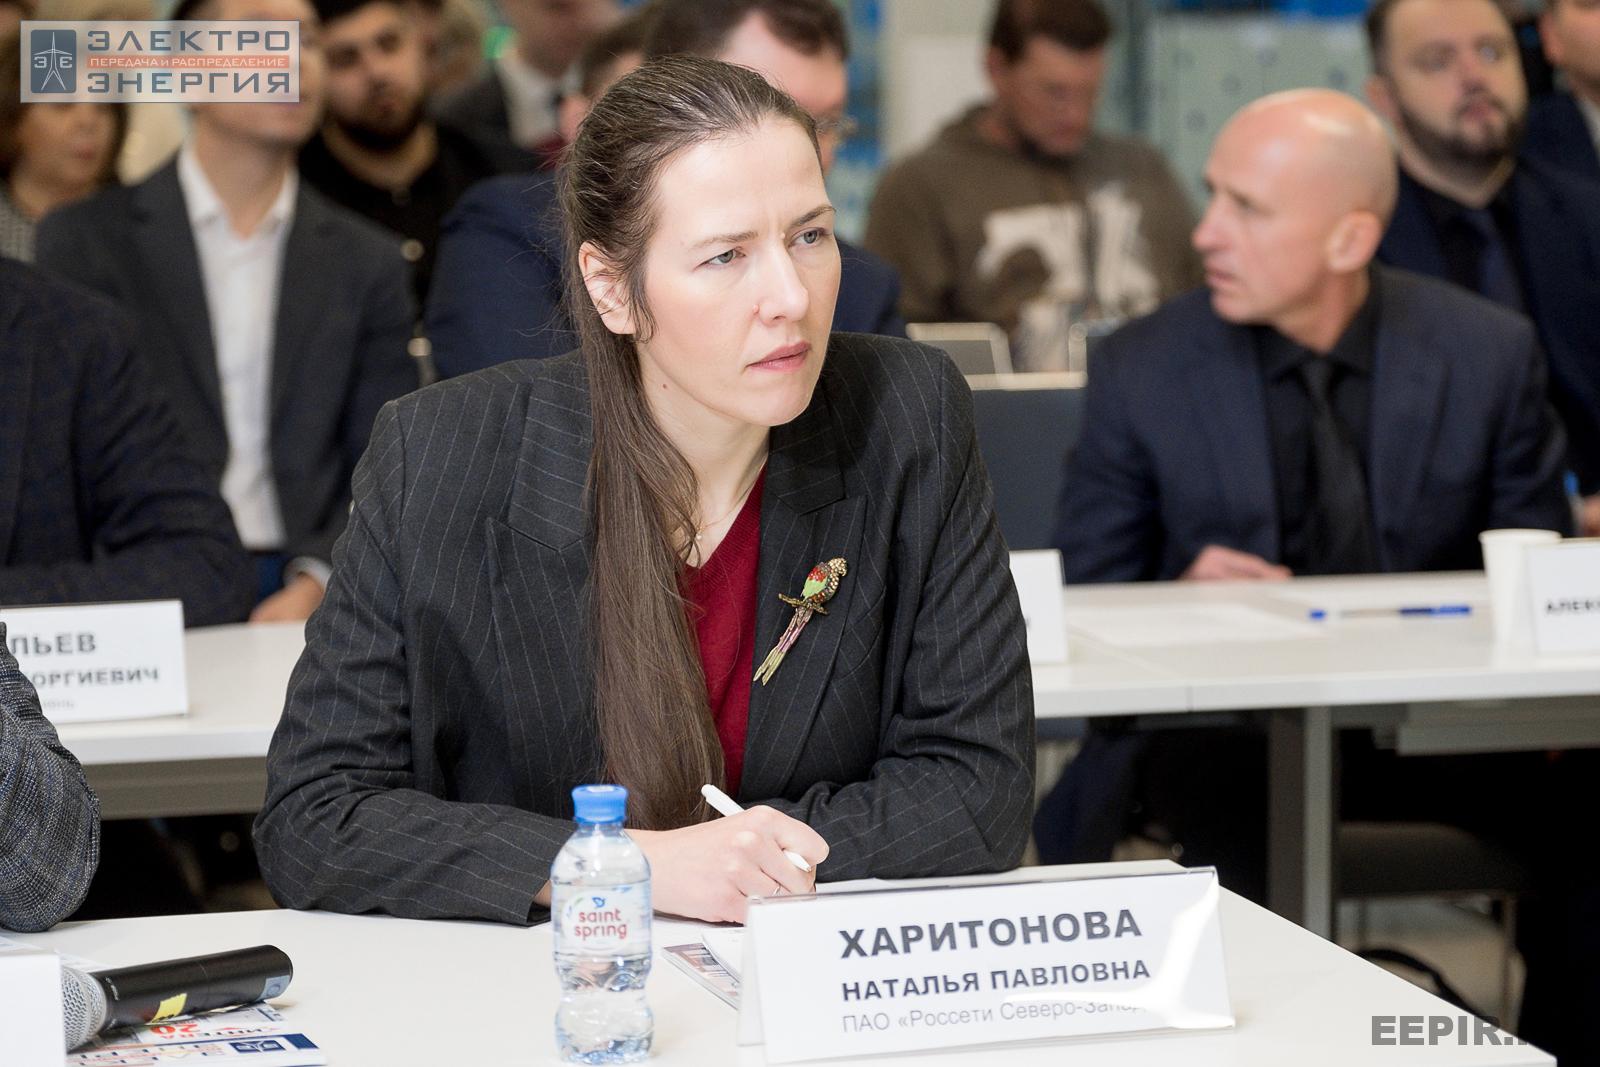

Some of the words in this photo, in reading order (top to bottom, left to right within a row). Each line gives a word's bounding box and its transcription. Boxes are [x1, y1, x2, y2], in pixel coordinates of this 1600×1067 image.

[578, 908, 623, 922] saint
[574, 921, 628, 941] spring
[838, 909, 1142, 959] ХАРИТОНОВА
[842, 972, 980, 1001] НАТАЛЬЯ
[991, 959, 1151, 989] ПАВЛОВНА
[842, 1012, 891, 1033] ПАО
[898, 1008, 994, 1028] «Россети
